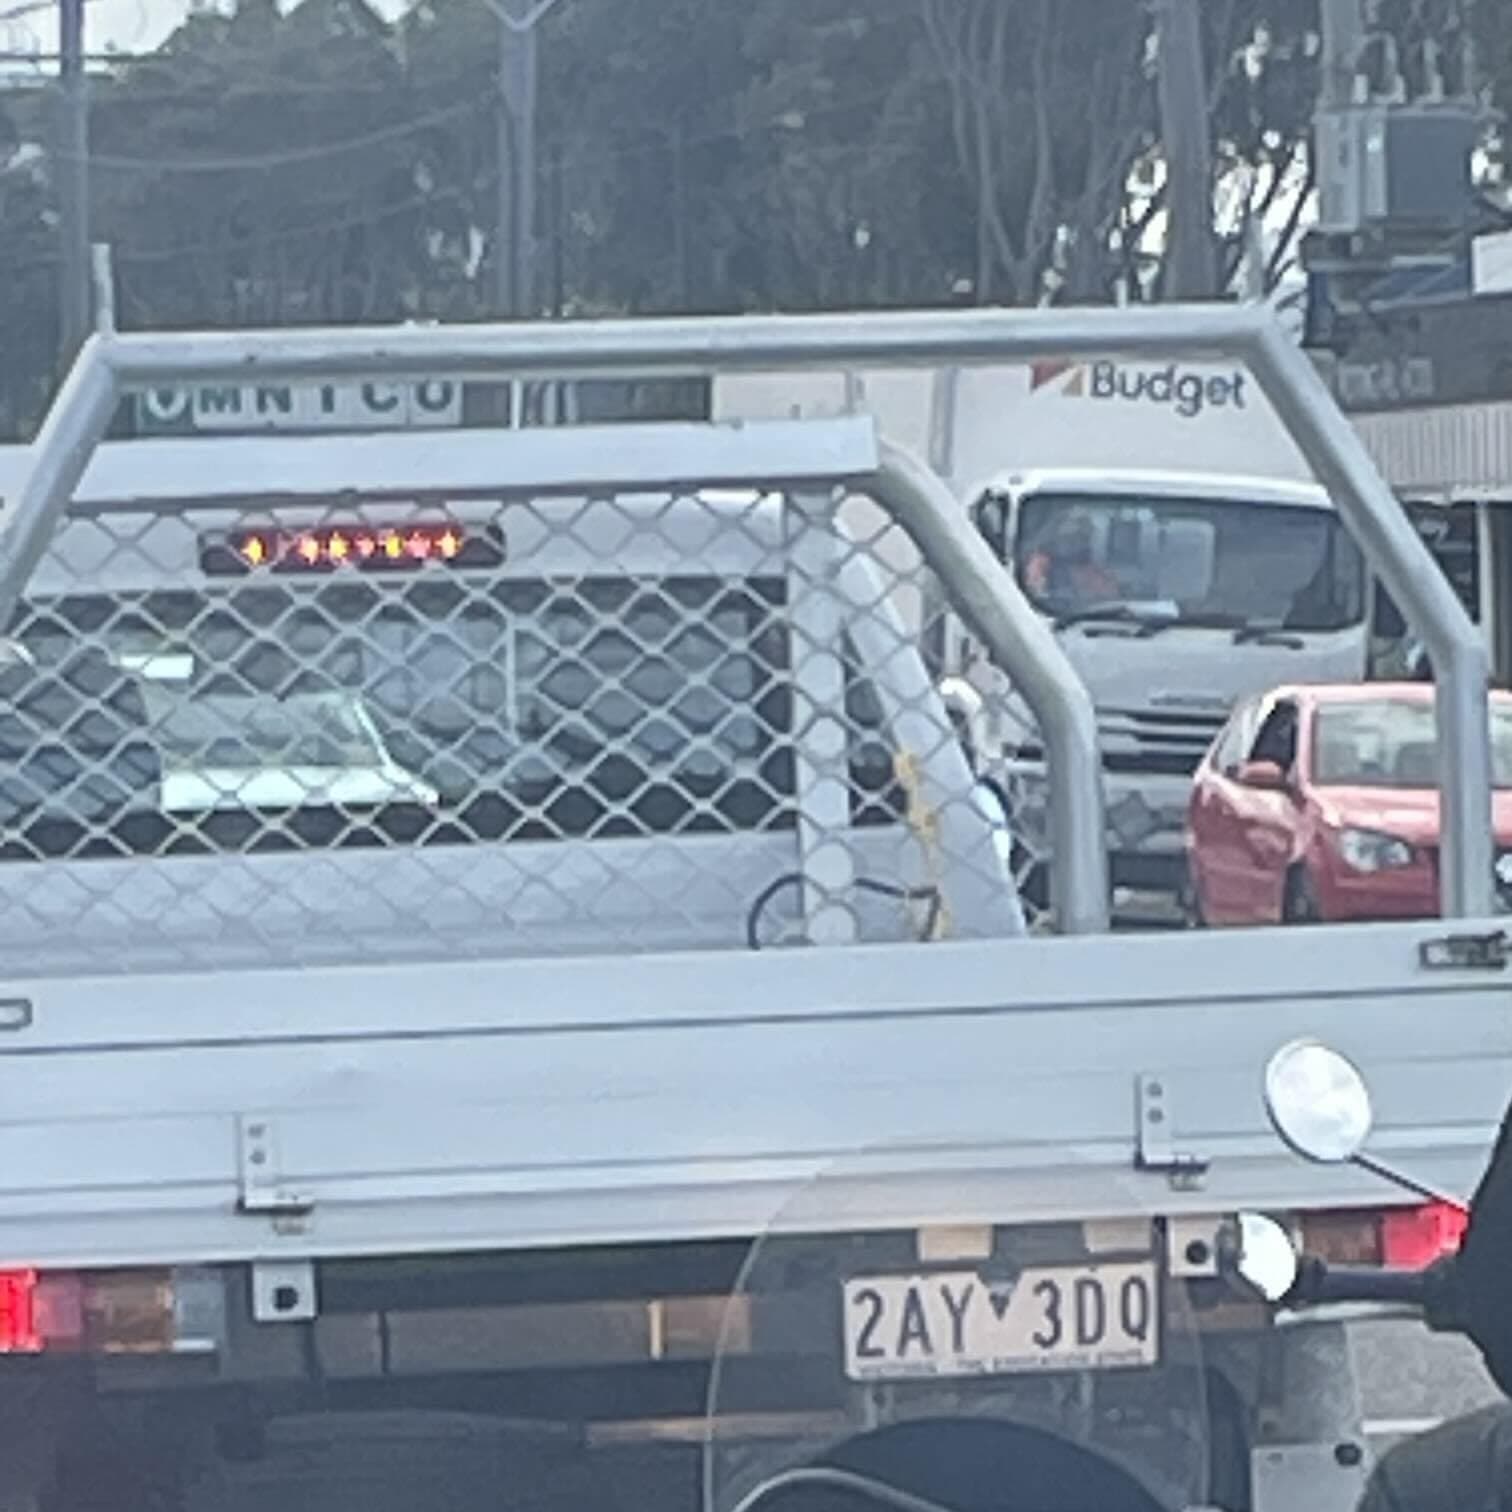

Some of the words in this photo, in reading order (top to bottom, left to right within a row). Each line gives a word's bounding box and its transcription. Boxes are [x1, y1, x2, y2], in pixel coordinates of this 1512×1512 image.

[1090, 361, 1246, 417] Budget
[853, 1282, 975, 1359] 2AY
[1031, 1274, 1151, 1349] 3DQ
